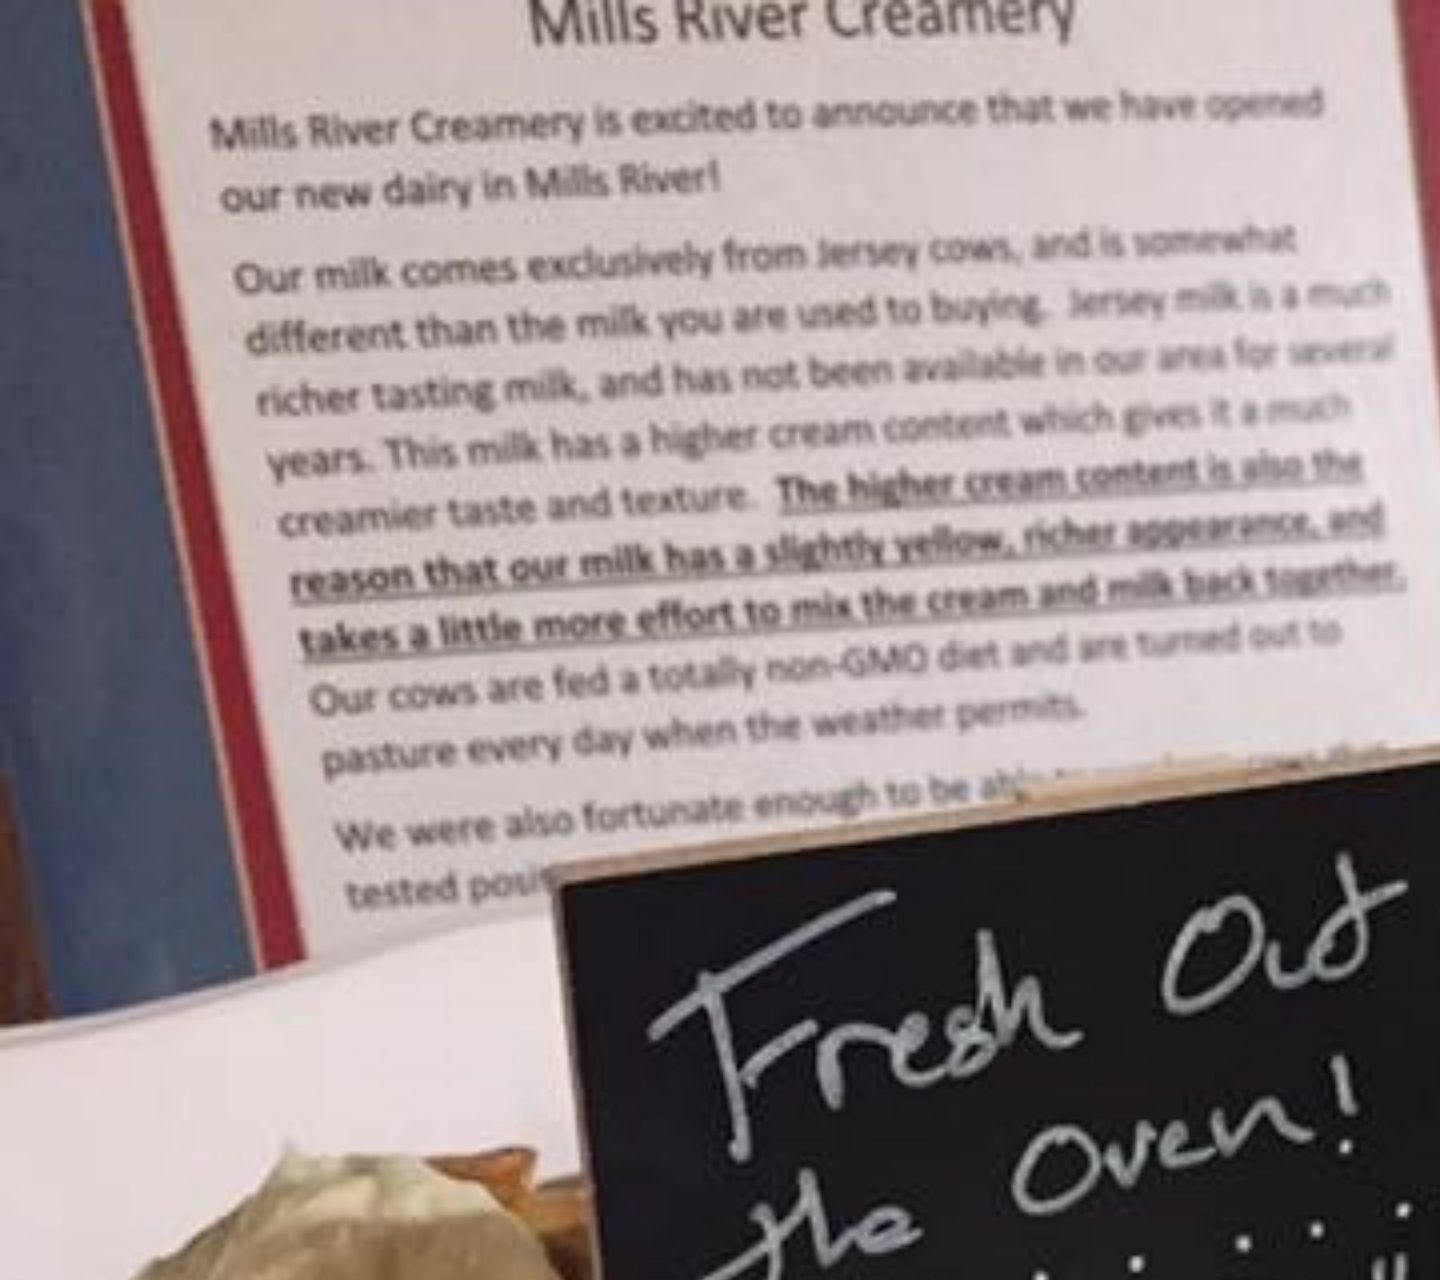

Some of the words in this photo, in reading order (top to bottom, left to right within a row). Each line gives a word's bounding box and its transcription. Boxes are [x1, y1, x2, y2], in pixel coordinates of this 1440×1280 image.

[531, 0, 658, 47] Mills
[676, 0, 806, 43] River
[826, 0, 1075, 44] Creamery
[210, 116, 297, 150] Mills
[309, 114, 399, 148] River
[411, 109, 584, 150] Creamery
[594, 104, 621, 138] is
[631, 101, 756, 137] excited
[768, 101, 800, 131] to
[811, 101, 980, 130] announce
[987, 90, 1056, 125] that
[1065, 96, 1108, 124] we
[1119, 87, 1195, 122] have
[1206, 86, 1325, 122] opened
[221, 186, 281, 214] our
[297, 180, 371, 210] new
[383, 172, 471, 210] dairy
[484, 169, 515, 201] in
[525, 165, 609, 200] Mills
[619, 160, 721, 194] River!
[233, 264, 300, 295] Our
[315, 256, 391, 293] milk
[402, 257, 515, 289] comes
[527, 242, 713, 284] exclusively
[724, 238, 805, 272] from
[816, 238, 918, 271] Jersey
[928, 236, 1021, 265] cows,
[1031, 229, 1090, 261] and
[1102, 227, 1125, 258] is
[1134, 223, 1296, 258] somewhat
[246, 321, 406, 356] different
[415, 312, 497, 348] than
[508, 311, 567, 344] the
[576, 301, 649, 340] milk
[658, 307, 723, 339] you
[734, 298, 787, 332] are
[798, 293, 876, 331] used
[887, 293, 921, 324] to
[931, 287, 1047, 328] buying.
[1068, 284, 1165, 321] Jersey
[1175, 279, 1242, 314] milk
[1247, 279, 1272, 312] is
[1282, 284, 1299, 310] a
[1307, 278, 1392, 307] much
[257, 381, 359, 417] richer
[373, 377, 496, 413] tasting
[504, 369, 589, 405] milk,
[599, 365, 664, 399] and
[673, 361, 731, 396] has
[742, 358, 799, 390] not
[808, 353, 893, 387] been
[904, 342, 1044, 383] available
[1056, 343, 1085, 375] in
[1094, 346, 1147, 375] our
[1156, 339, 1226, 372] area
[1235, 332, 1278, 366] for
[1287, 328, 1393, 364] several
[268, 448, 374, 486] years.
[384, 438, 457, 471] This
[467, 429, 543, 464] milk
[552, 424, 609, 459] has
[621, 425, 641, 458] a
[650, 418, 758, 459] higher
[768, 418, 875, 450] cream
[883, 409, 1010, 443] content
[1019, 402, 1114, 436] which
[1124, 402, 1202, 437] gives
[1211, 395, 1231, 428] it
[1242, 396, 1258, 425] a
[1267, 391, 1349, 424] much
[277, 505, 439, 539] creamier
[448, 496, 537, 528] taste
[546, 489, 612, 521] and
[622, 486, 758, 517] texture.
[776, 475, 839, 509] The
[846, 466, 954, 505] higher
[964, 461, 1069, 496] cream
[1077, 455, 1197, 491] content
[1208, 454, 1233, 486] is
[1242, 453, 1304, 483] also
[1314, 447, 1364, 480] the
[291, 568, 415, 600] reason
[425, 558, 499, 589] that
[510, 554, 567, 584] our
[580, 540, 655, 578] milk
[666, 537, 725, 574] has
[736, 542, 754, 570] a
[765, 529, 884, 571] slightly
[898, 521, 1016, 565] yellow,
[1022, 518, 1118, 551] richer
[1126, 507, 1320, 548] appearance,
[1328, 502, 1385, 537] and
[300, 624, 399, 657] takes
[409, 621, 430, 651] a
[439, 613, 522, 647] little
[533, 609, 626, 641] more
[637, 598, 736, 637] effort
[745, 598, 781, 630] to
[791, 591, 854, 624] mix
[862, 584, 917, 619] the
[927, 581, 1028, 614] cream
[1039, 573, 1099, 609] and
[1107, 568, 1174, 602] milk
[1184, 562, 1255, 598] back
[1264, 557, 1407, 600] together.
[309, 682, 376, 719] Our
[388, 675, 479, 710] cows
[488, 671, 544, 703] are
[553, 663, 610, 699] fed
[621, 666, 639, 694] a
[649, 655, 756, 694] totally
[767, 642, 928, 682] non-GMO
[939, 633, 1000, 673] diet
[1010, 630, 1070, 666] and
[1079, 628, 1130, 662] are
[1137, 619, 1241, 658] turned
[1249, 618, 1297, 650] out
[1308, 617, 1342, 646] to
[322, 740, 455, 782] pasture
[466, 732, 561, 767] every
[571, 718, 633, 759] day
[644, 714, 737, 748] when
[746, 707, 801, 740] the
[811, 700, 946, 737] weather
[957, 692, 1086, 734] permits.
[335, 817, 398, 852] We
[406, 815, 494, 848] were
[505, 803, 574, 838] also
[582, 792, 746, 833] fortunate
[754, 781, 877, 822] enough
[886, 779, 921, 806] to
[928, 772, 969, 805] be
[346, 875, 459, 910] tested
[647, 889, 1085, 1162] Fresh
[1163, 853, 1408, 1015] Out
[1011, 1057, 1359, 1216] Oven!
